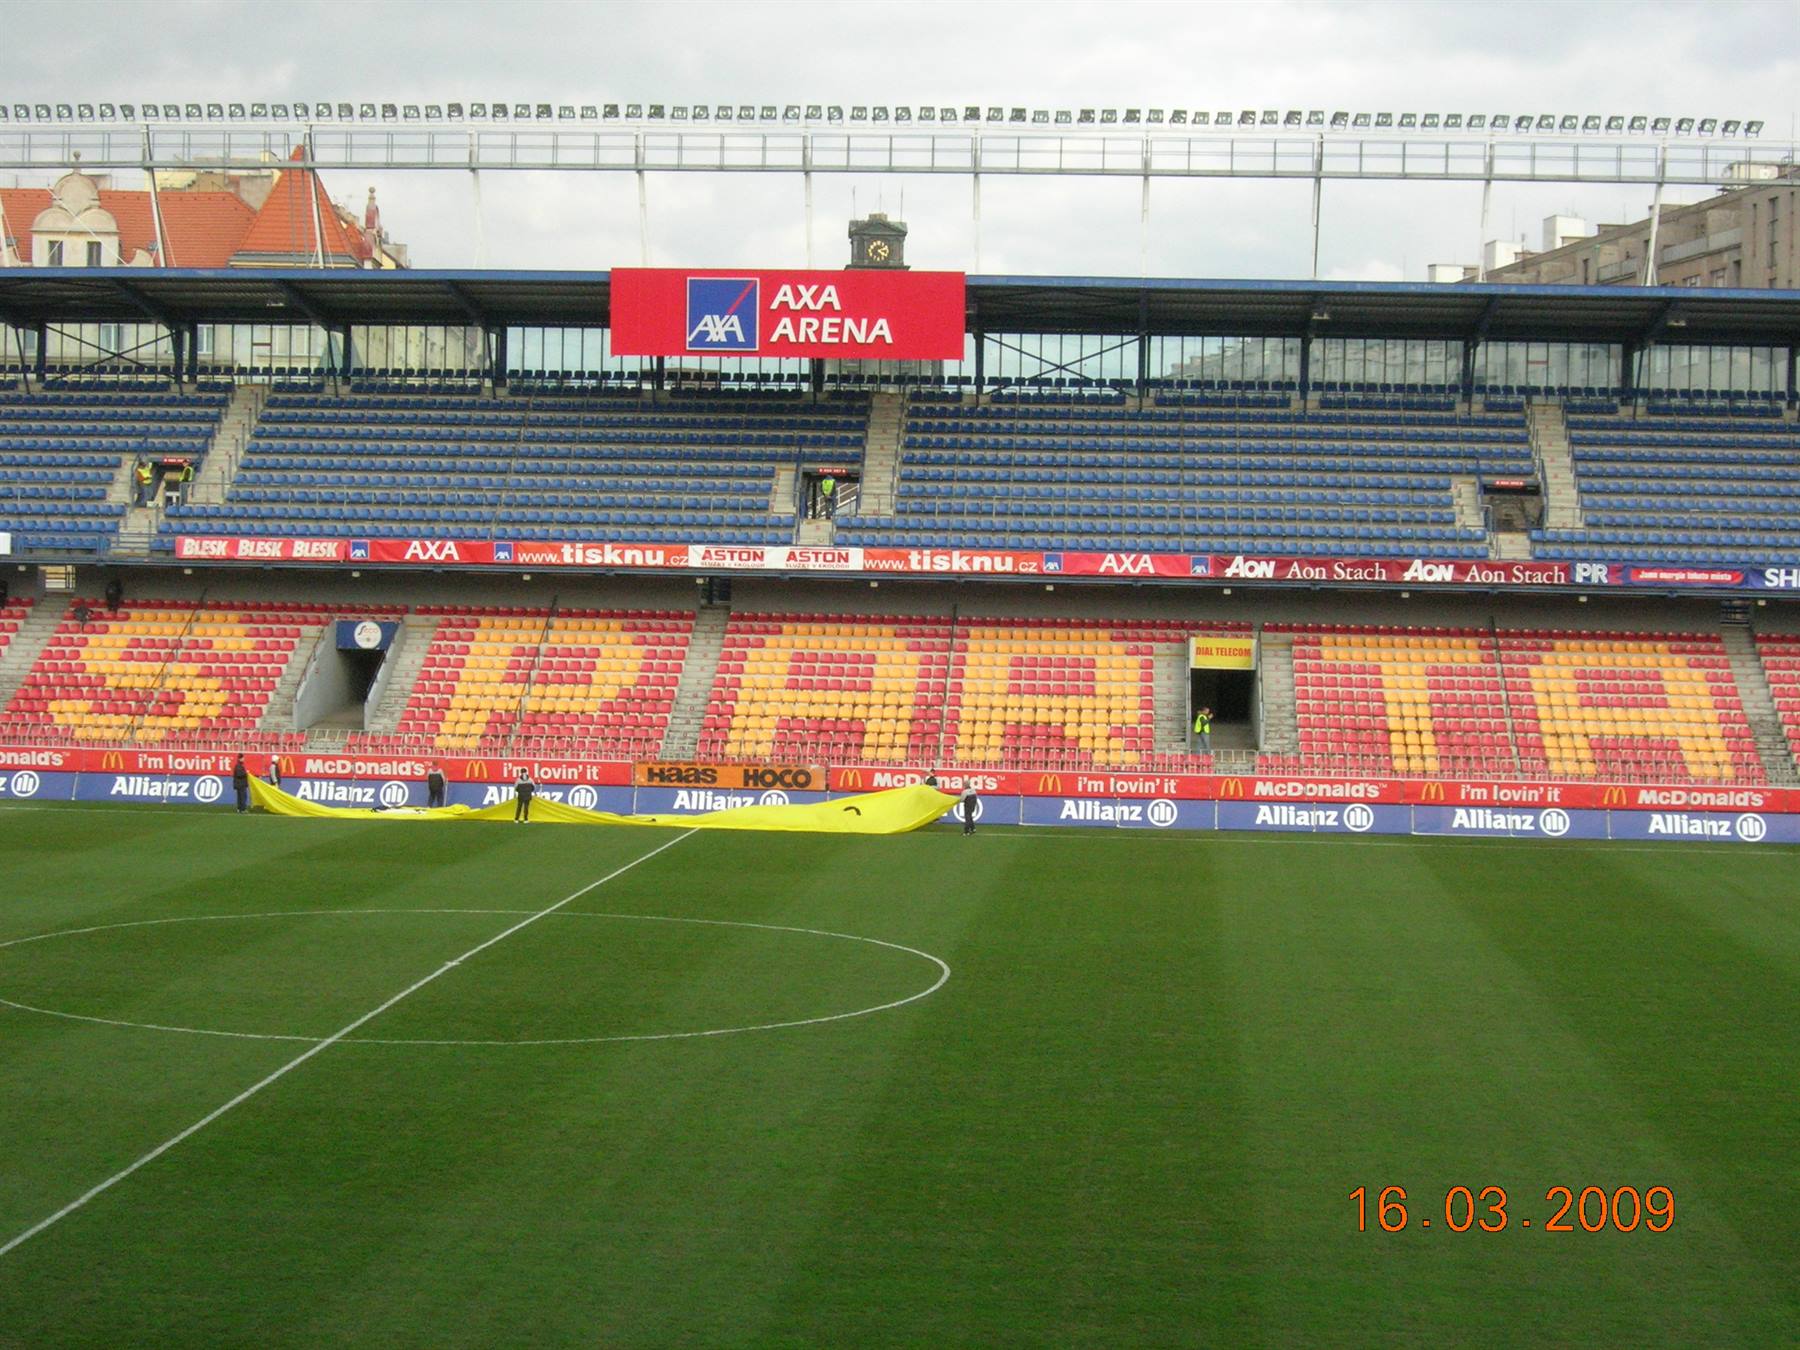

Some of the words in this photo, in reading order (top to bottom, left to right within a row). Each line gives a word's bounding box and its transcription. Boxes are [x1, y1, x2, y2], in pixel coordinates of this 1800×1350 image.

[770, 284, 843, 312] AXA
[688, 314, 746, 344] AXA
[770, 316, 894, 345] ARENA
[182, 537, 228, 557] BLESK
[237, 538, 282, 557] BLESK
[291, 539, 338, 558] BLESK
[404, 541, 459, 560] AXA
[517, 543, 689, 566] www.tisknu.cz
[701, 549, 765, 562] ASTON
[786, 551, 850, 563] ASTON
[864, 551, 1038, 572] www.tisknu.cz
[1099, 554, 1156, 573] AXA
[1286, 565, 1327, 580] Aon
[1333, 564, 1386, 581] Stach
[1465, 566, 1505, 582] Aon
[1512, 566, 1566, 584] Stach
[1764, 568, 1800, 588] SH
[1195, 646, 1214, 656] DIAL
[1216, 647, 1252, 657] TELECOM
[137, 753, 164, 769] i'm
[168, 753, 216, 771] lovin'
[219, 757, 231, 771] it
[305, 759, 425, 777] McDonald's
[535, 763, 583, 781] lovin'
[587, 765, 600, 781] it
[110, 776, 189, 797] Allianz
[743, 769, 812, 788] HOCO
[1078, 777, 1105, 792] i'm
[1111, 777, 1160, 794] lovin'
[1163, 779, 1177, 794] it
[295, 781, 375, 802] Allianz
[1254, 781, 1379, 799] McDonald's
[1460, 784, 1488, 801] i'm
[1493, 784, 1541, 803] lovin'
[1546, 786, 1560, 803] it
[1638, 789, 1764, 808] McDonald's
[1060, 800, 1142, 821] Allianz
[1255, 806, 1338, 826] Allianz
[1452, 809, 1535, 830] Allianz
[1648, 814, 1731, 836] Allianz
